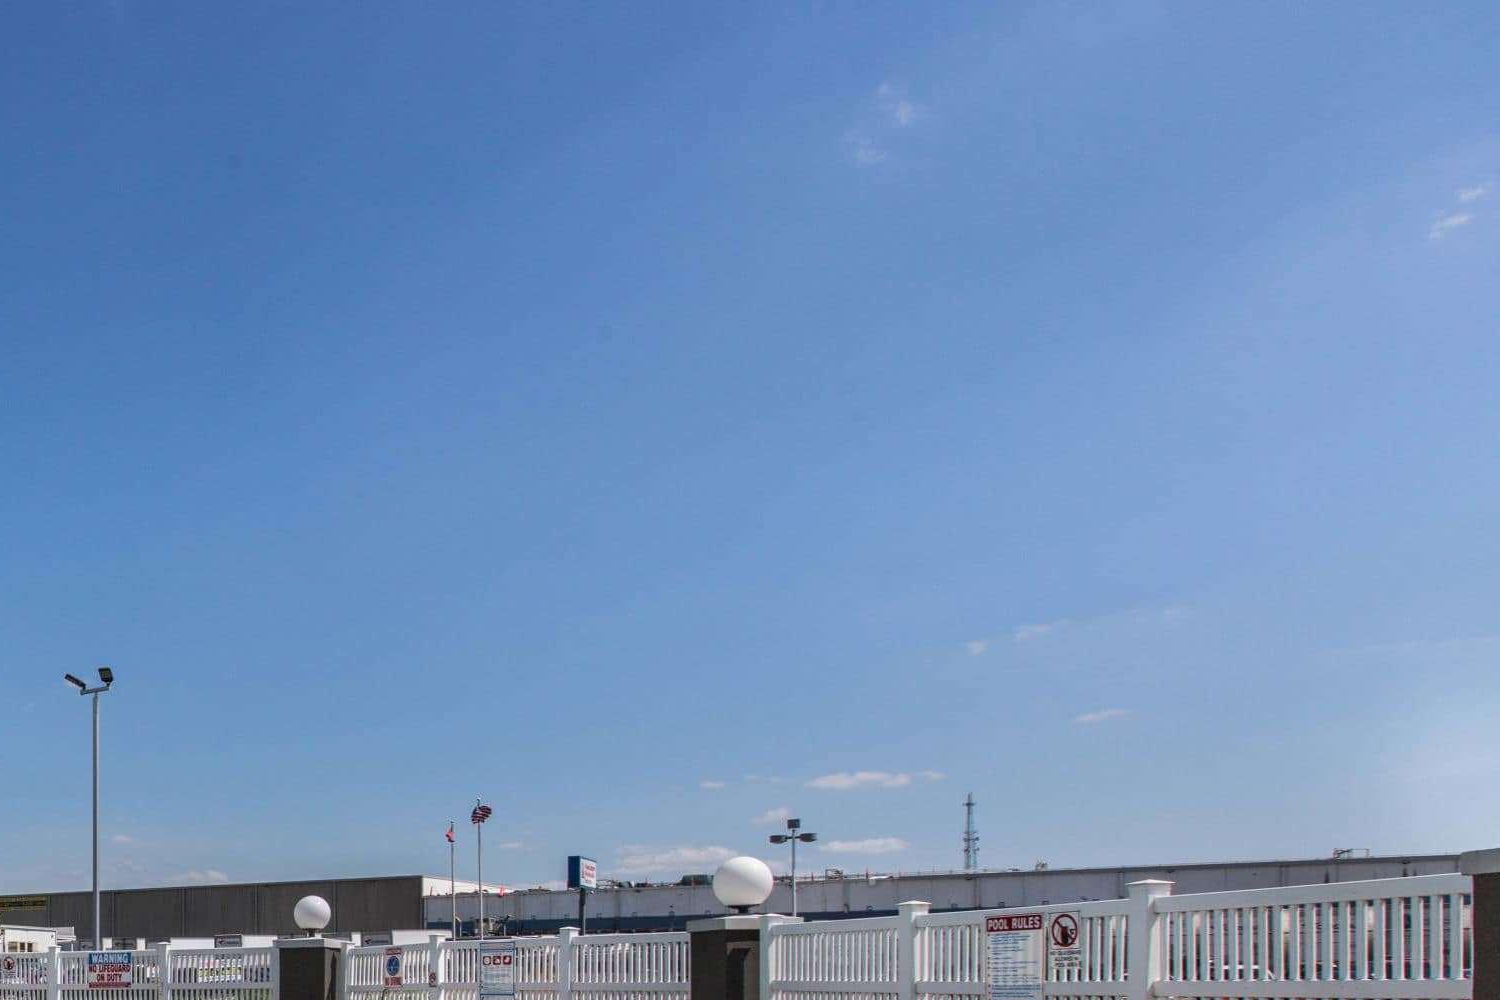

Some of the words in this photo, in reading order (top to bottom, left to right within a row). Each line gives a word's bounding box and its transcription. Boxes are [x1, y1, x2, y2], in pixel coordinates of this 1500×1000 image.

[988, 919, 1008, 931] POOL
[1012, 917, 1040, 929] RULES
[91, 953, 129, 963] WARNING
[89, 965, 97, 973] NO
[99, 964, 131, 972] LIFEGUARD
[97, 974, 105, 982] ON
[107, 973, 122, 981] DUTY
